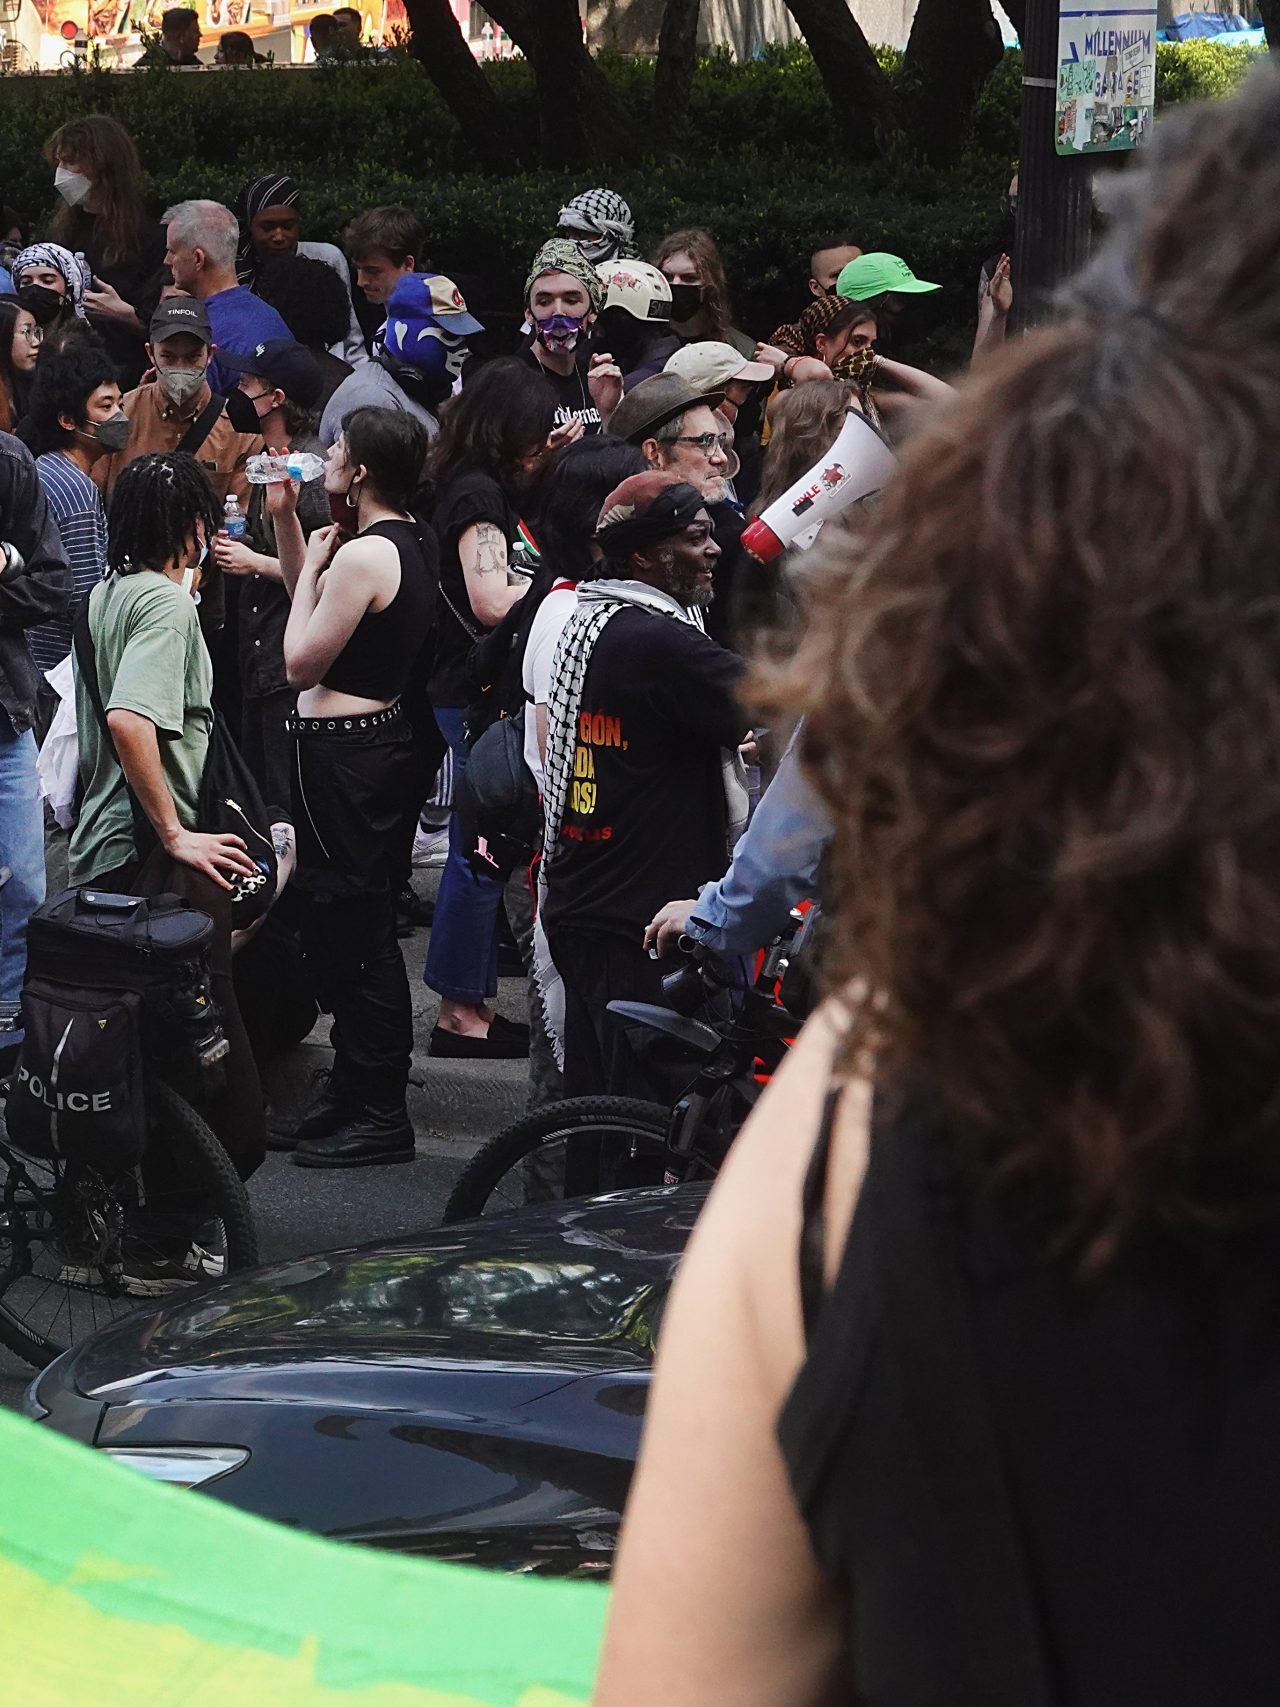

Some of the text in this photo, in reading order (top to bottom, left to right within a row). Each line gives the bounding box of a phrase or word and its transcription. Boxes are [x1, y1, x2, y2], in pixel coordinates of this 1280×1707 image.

[1095, 70, 1139, 98] GAAE
[167, 309, 198, 318] TINFOIL
[17, 1065, 112, 1112] POLICE
